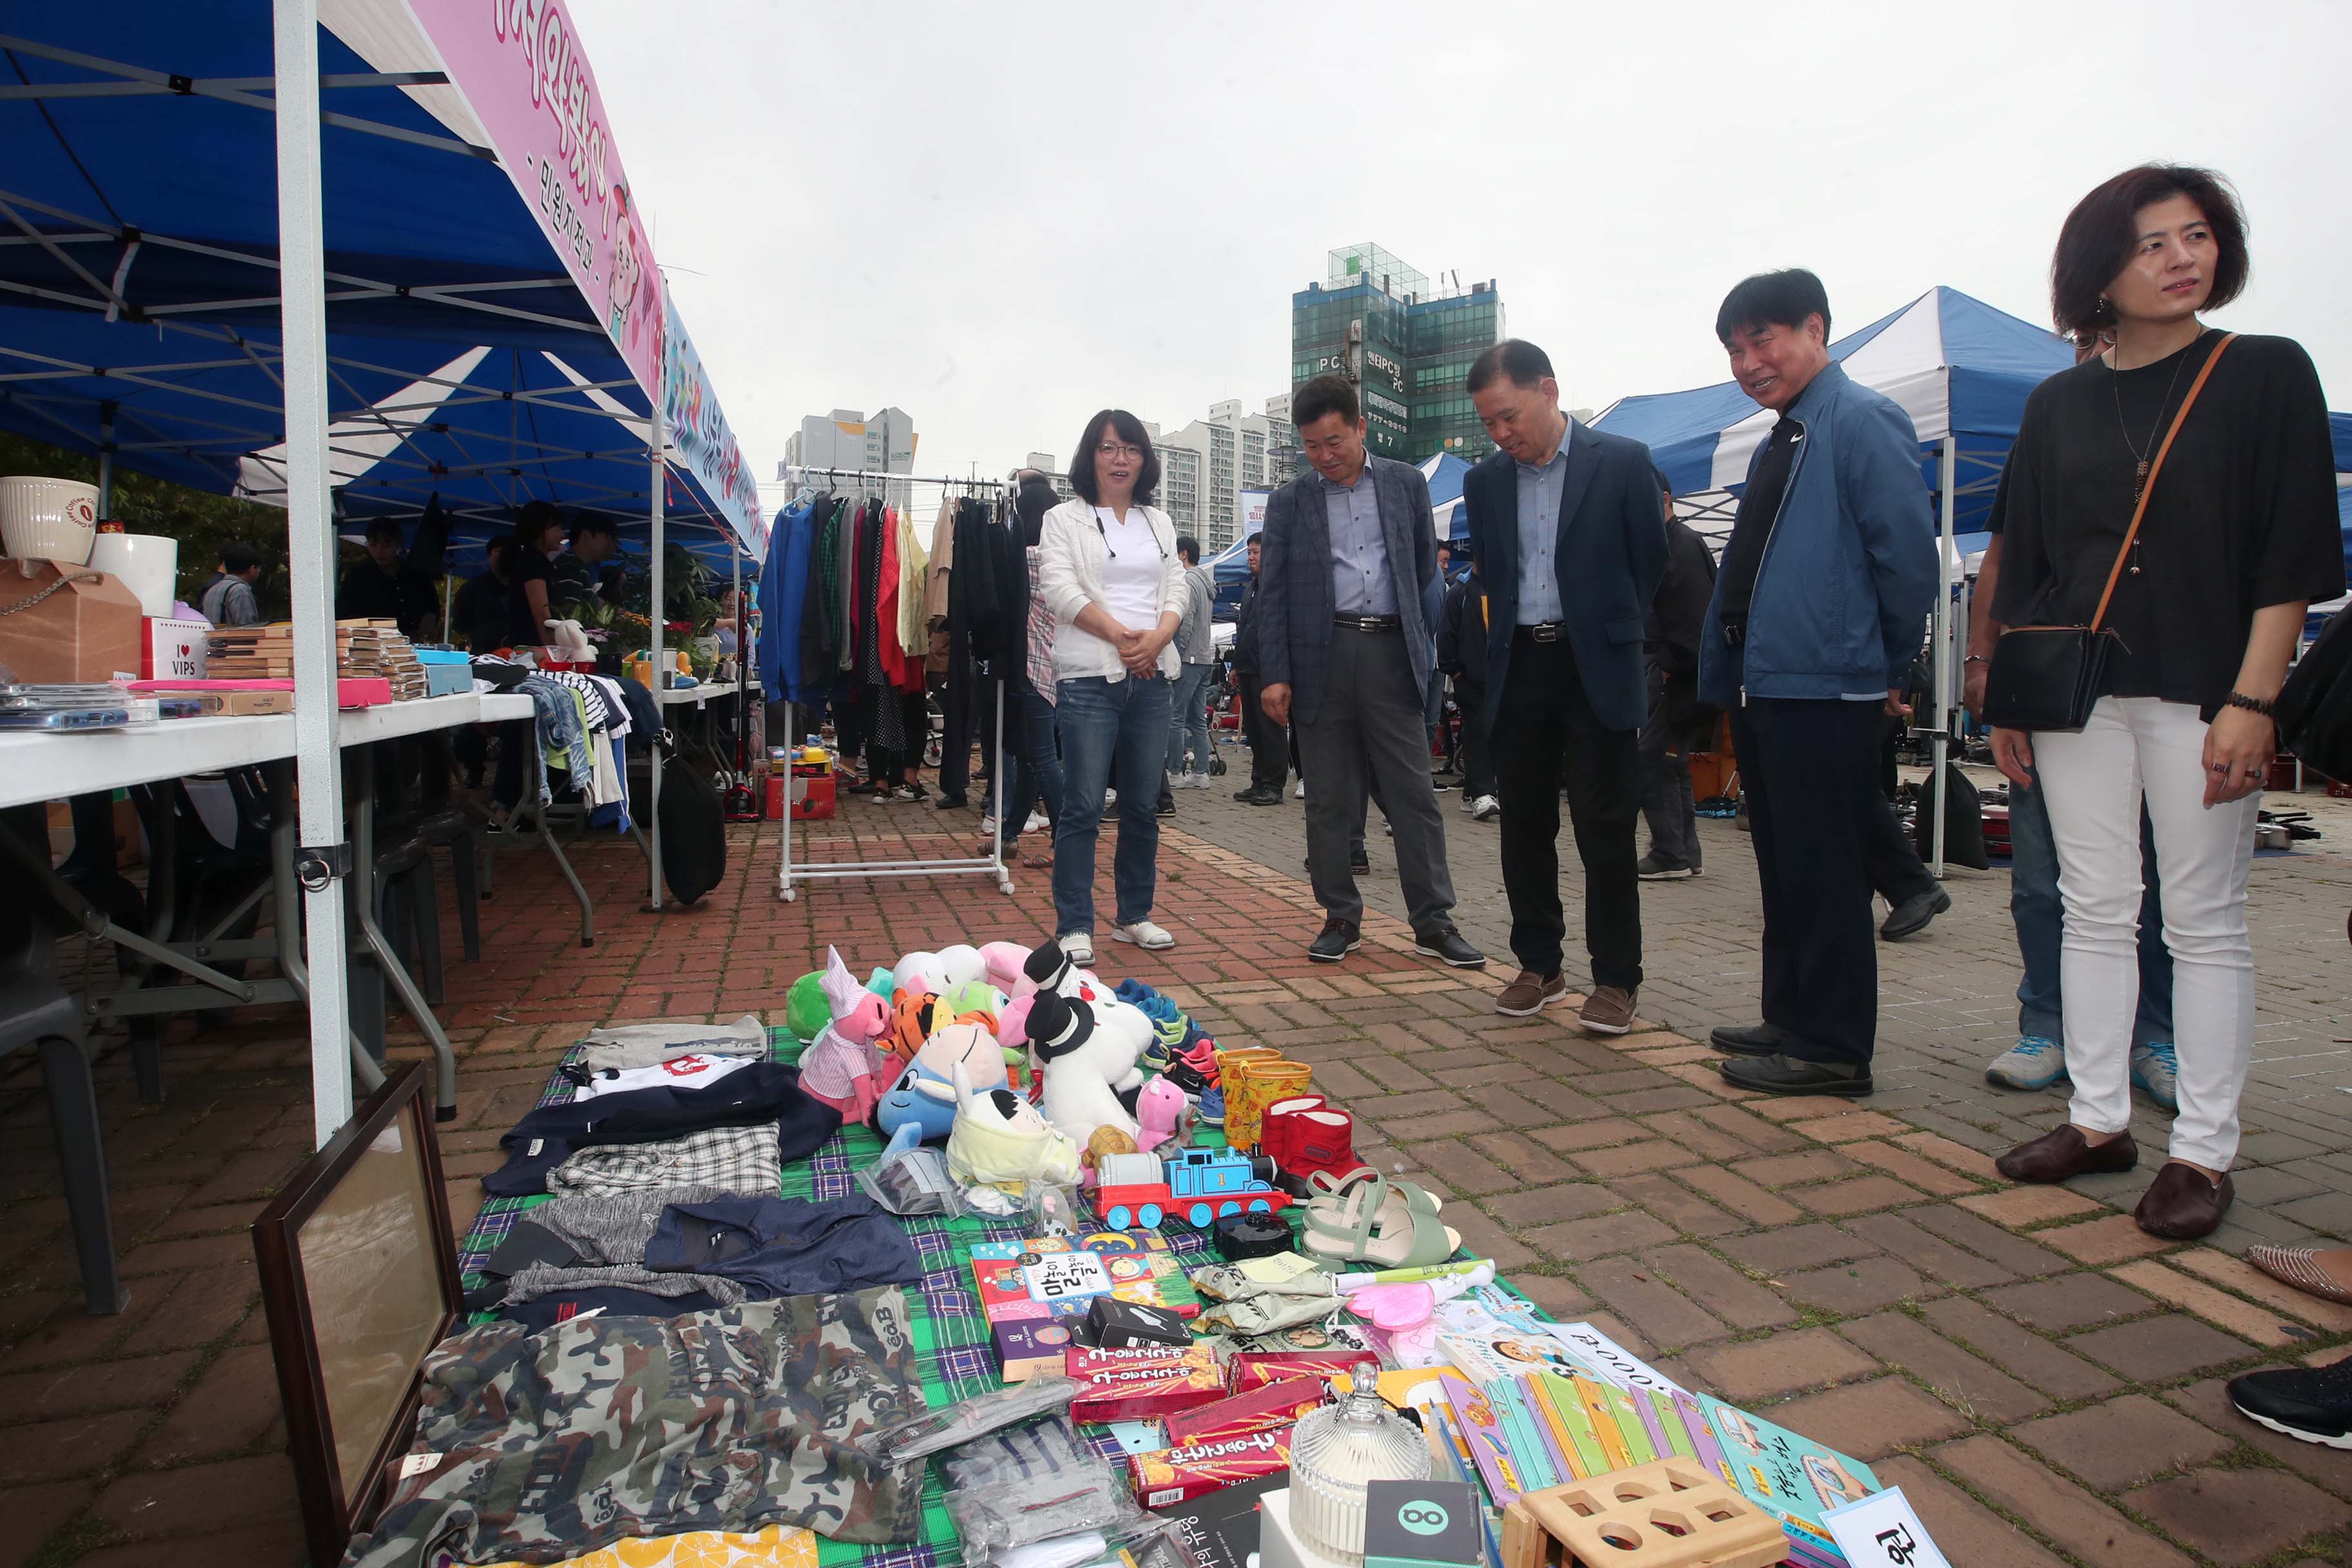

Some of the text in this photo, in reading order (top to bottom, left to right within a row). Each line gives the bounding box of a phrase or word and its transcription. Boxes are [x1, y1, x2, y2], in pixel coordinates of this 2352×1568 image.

[541, 159, 593, 282] 민원지적과
[172, 661, 195, 676] VIPS
[1571, 1333, 1667, 1391] ,000원
